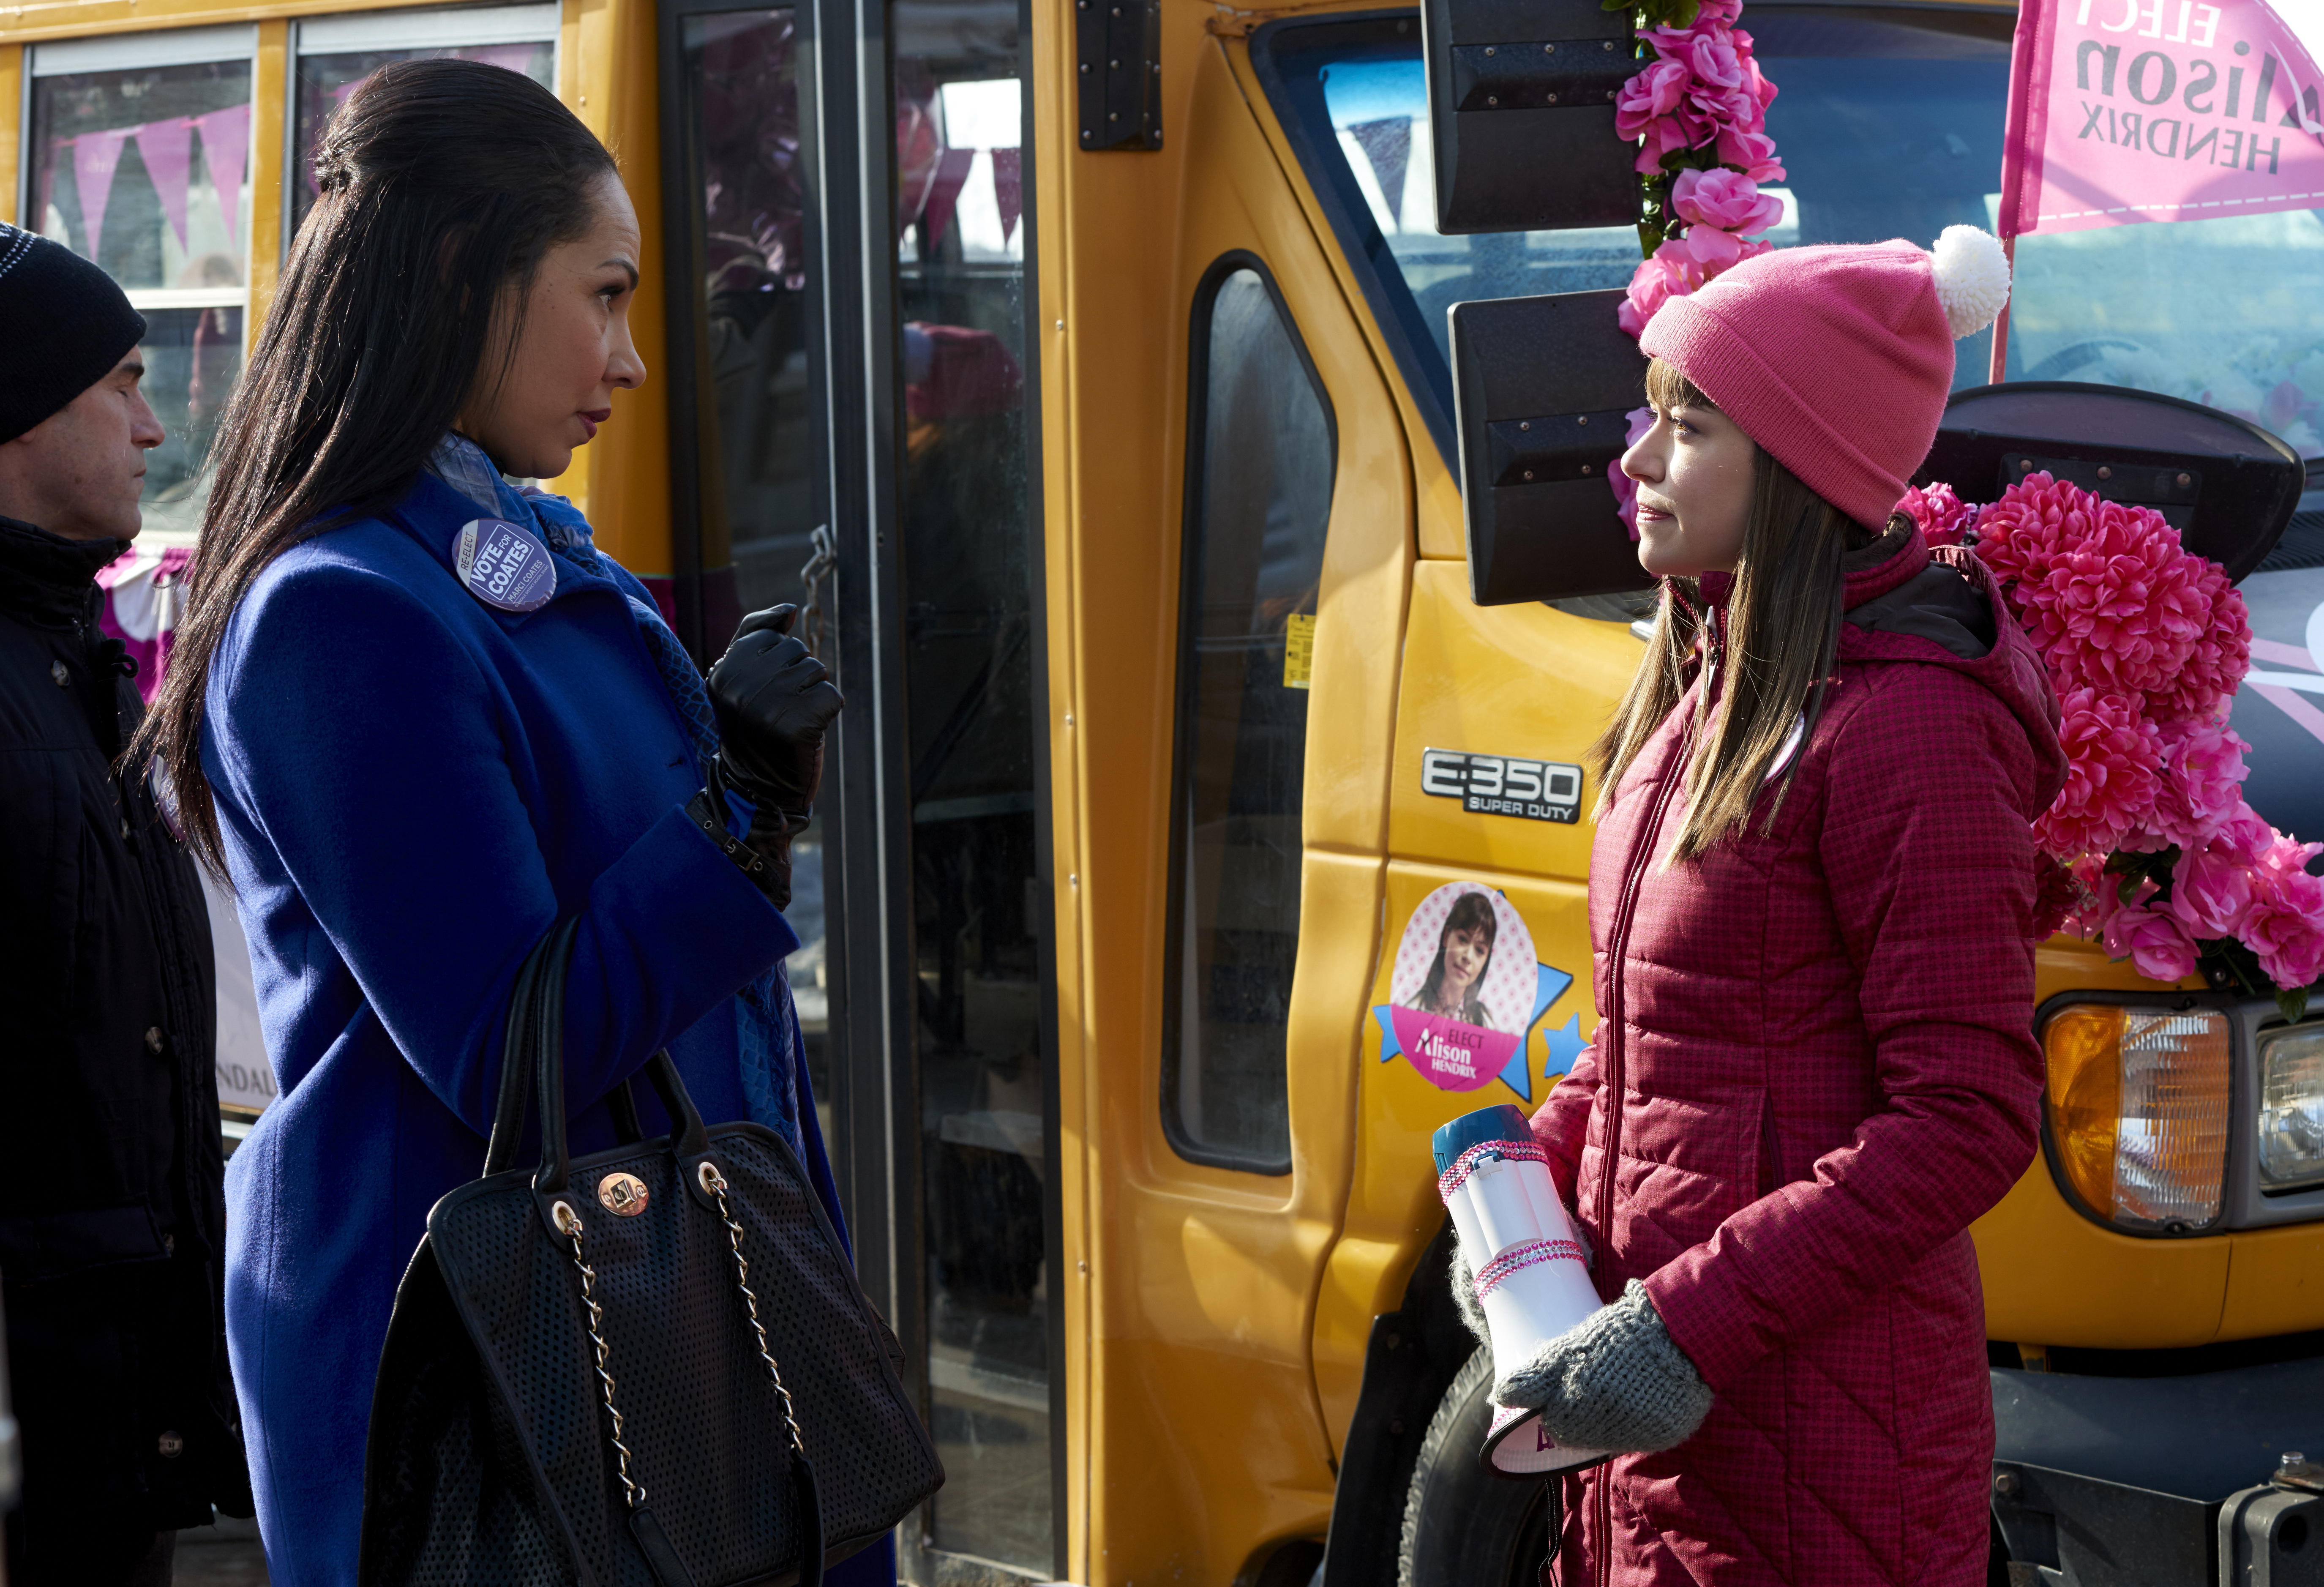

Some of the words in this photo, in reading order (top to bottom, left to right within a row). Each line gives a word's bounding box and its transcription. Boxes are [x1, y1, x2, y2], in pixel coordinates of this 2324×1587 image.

[461, 532, 474, 571] RE-ELECT
[471, 543, 503, 582] VOTE
[499, 534, 512, 549] FOR
[488, 540, 529, 594] COATES
[507, 581, 526, 602] MARCI
[523, 560, 543, 582] COATES
[533, 574, 543, 584] SCHOOL
[1468, 797, 1523, 815] SUPER
[1527, 803, 1573, 820] DUTY
[1415, 1028, 1471, 1065] Alison
[1448, 1029, 1484, 1049] ELECT
[1431, 1057, 1476, 1079] HENDRIX
